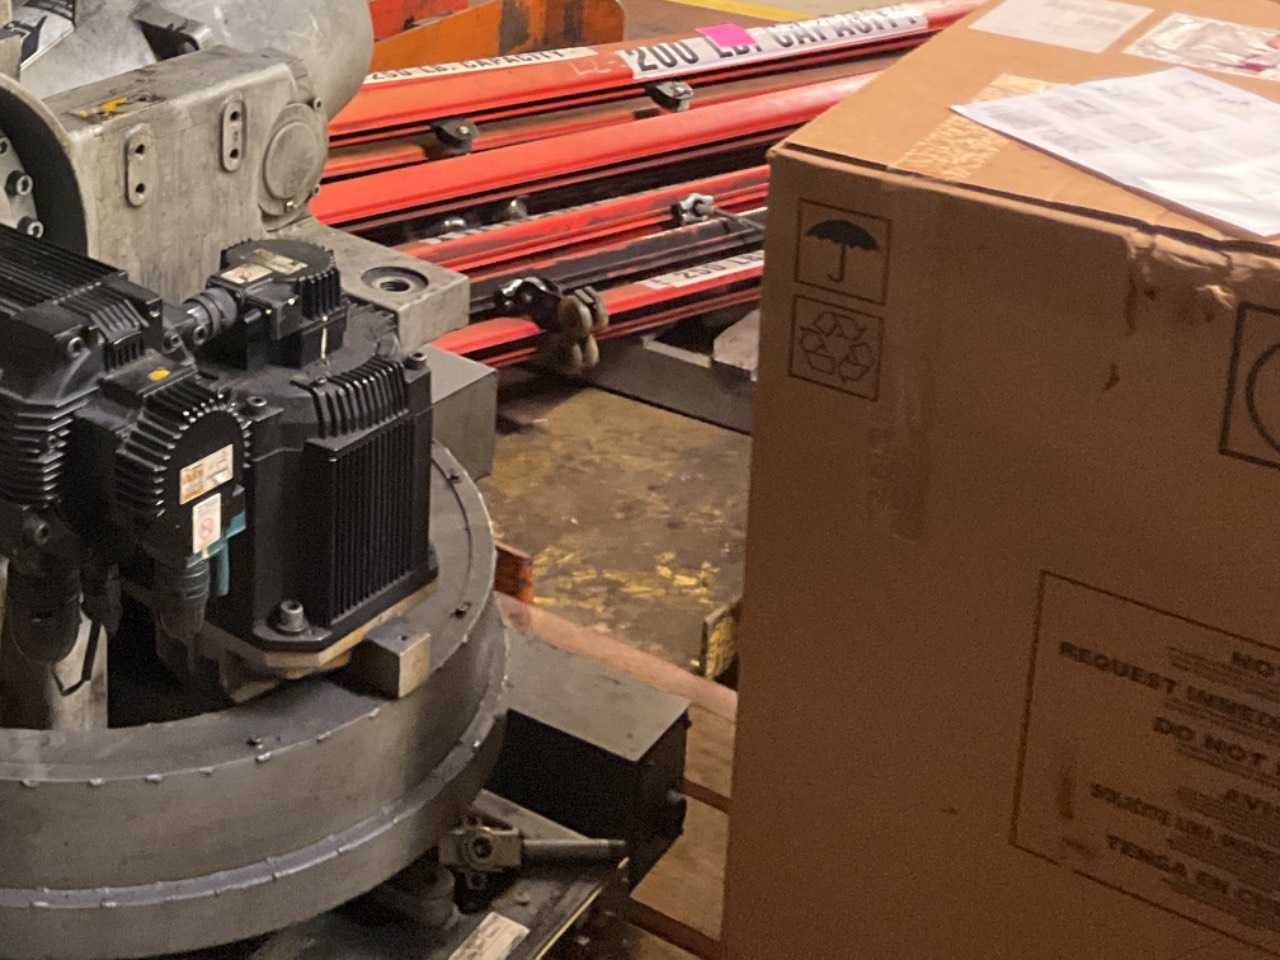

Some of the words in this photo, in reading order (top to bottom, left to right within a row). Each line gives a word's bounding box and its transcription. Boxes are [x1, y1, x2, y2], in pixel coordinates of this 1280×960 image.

[1059, 641, 1177, 694] REQUEST
[1187, 686, 1280, 731] IMMED
[1152, 716, 1195, 741] DO
[1204, 736, 1268, 767] NOT
